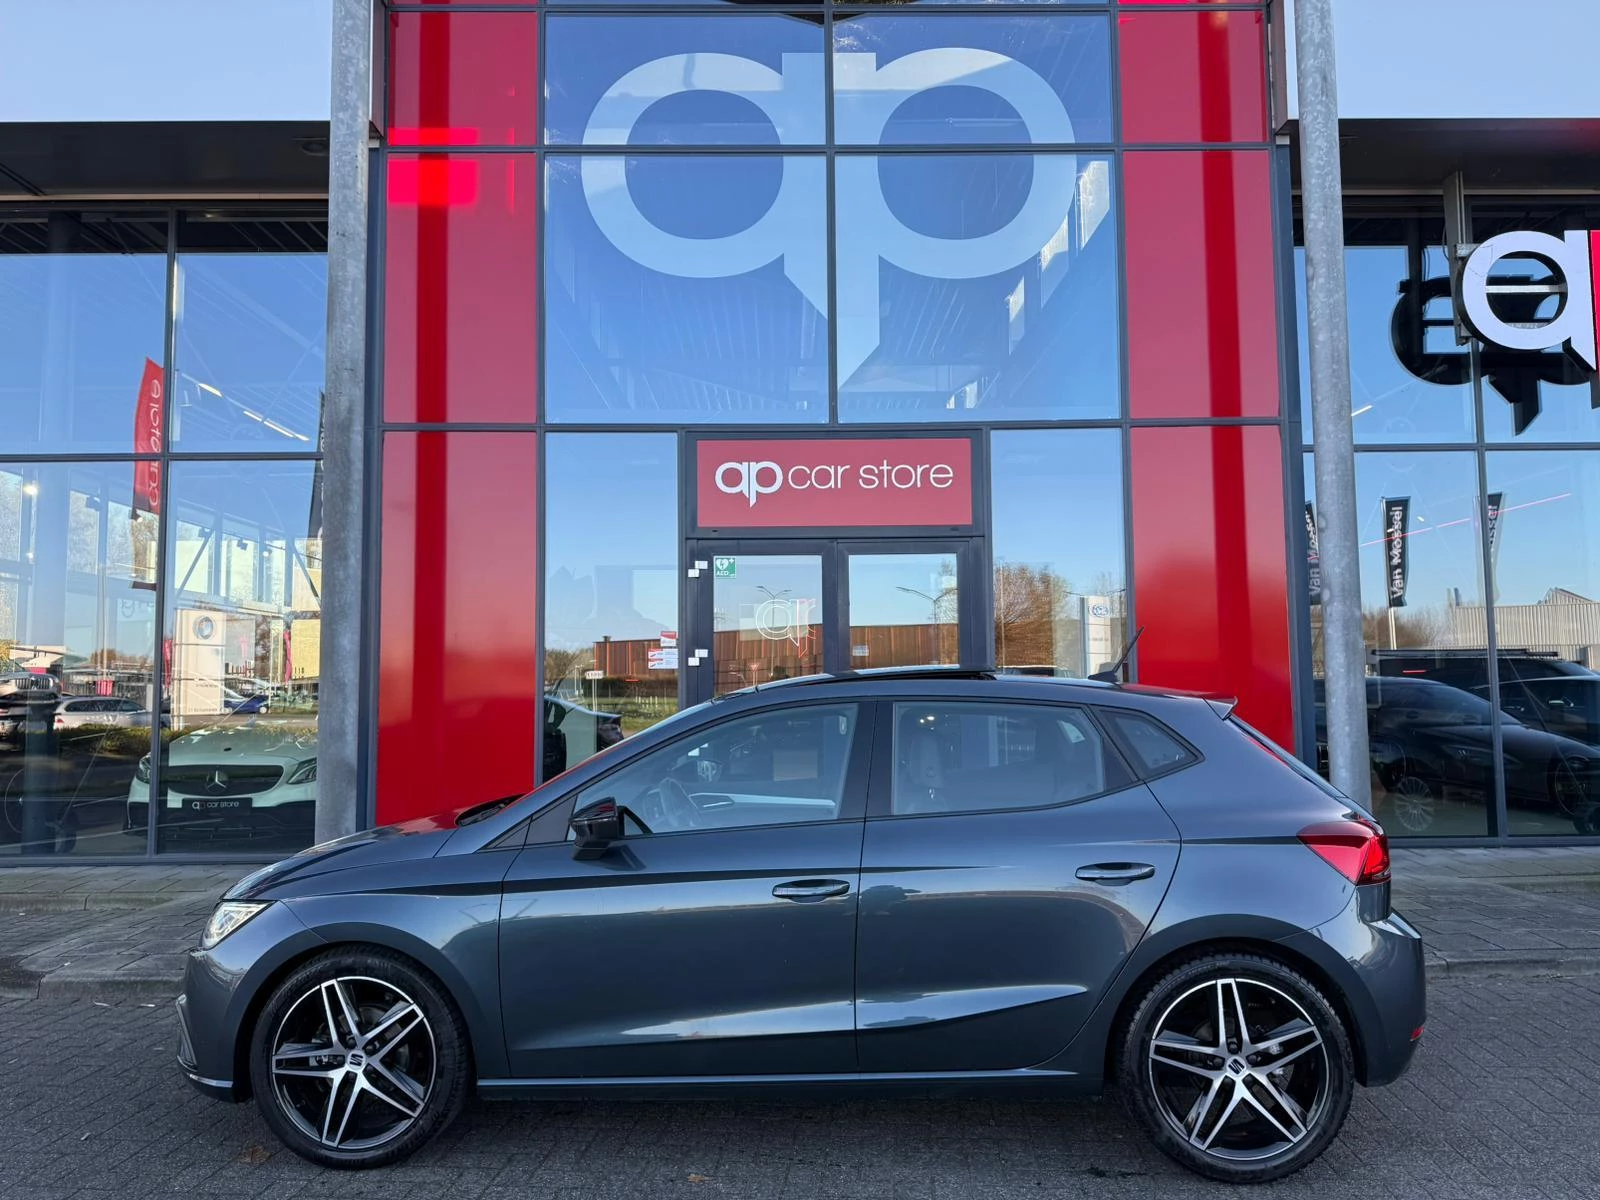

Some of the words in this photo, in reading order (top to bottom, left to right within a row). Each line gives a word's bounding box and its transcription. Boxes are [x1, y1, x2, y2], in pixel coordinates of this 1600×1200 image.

[581, 47, 1077, 390] ap
[1462, 230, 1600, 380] a
[715, 460, 783, 508] ap
[788, 464, 850, 489] car
[858, 459, 953, 489] store
[1389, 506, 1403, 566] Mossel
[1309, 568, 1321, 597] Van
[1389, 567, 1404, 598] Van
